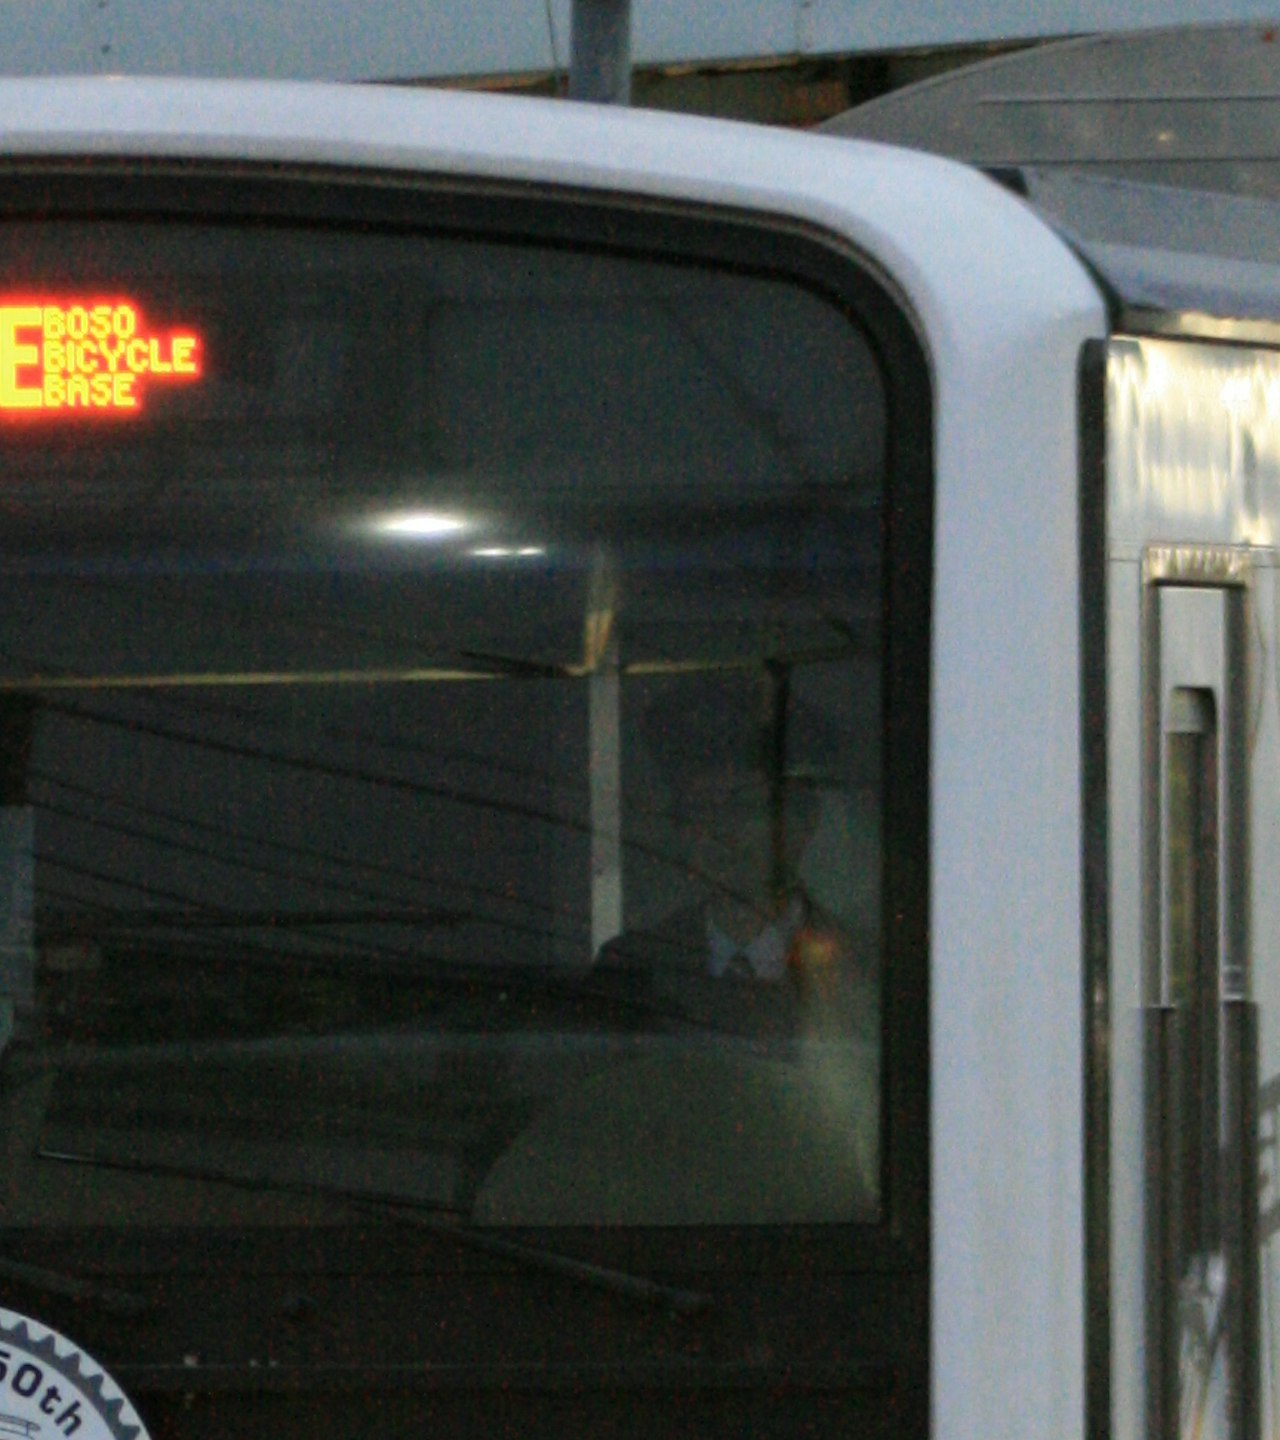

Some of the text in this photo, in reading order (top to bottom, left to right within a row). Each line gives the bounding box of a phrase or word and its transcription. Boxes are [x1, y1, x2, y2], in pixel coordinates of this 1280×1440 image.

[44, 306, 136, 340] BOSO
[44, 339, 196, 374] BICYCLE
[44, 374, 137, 409] BASE
